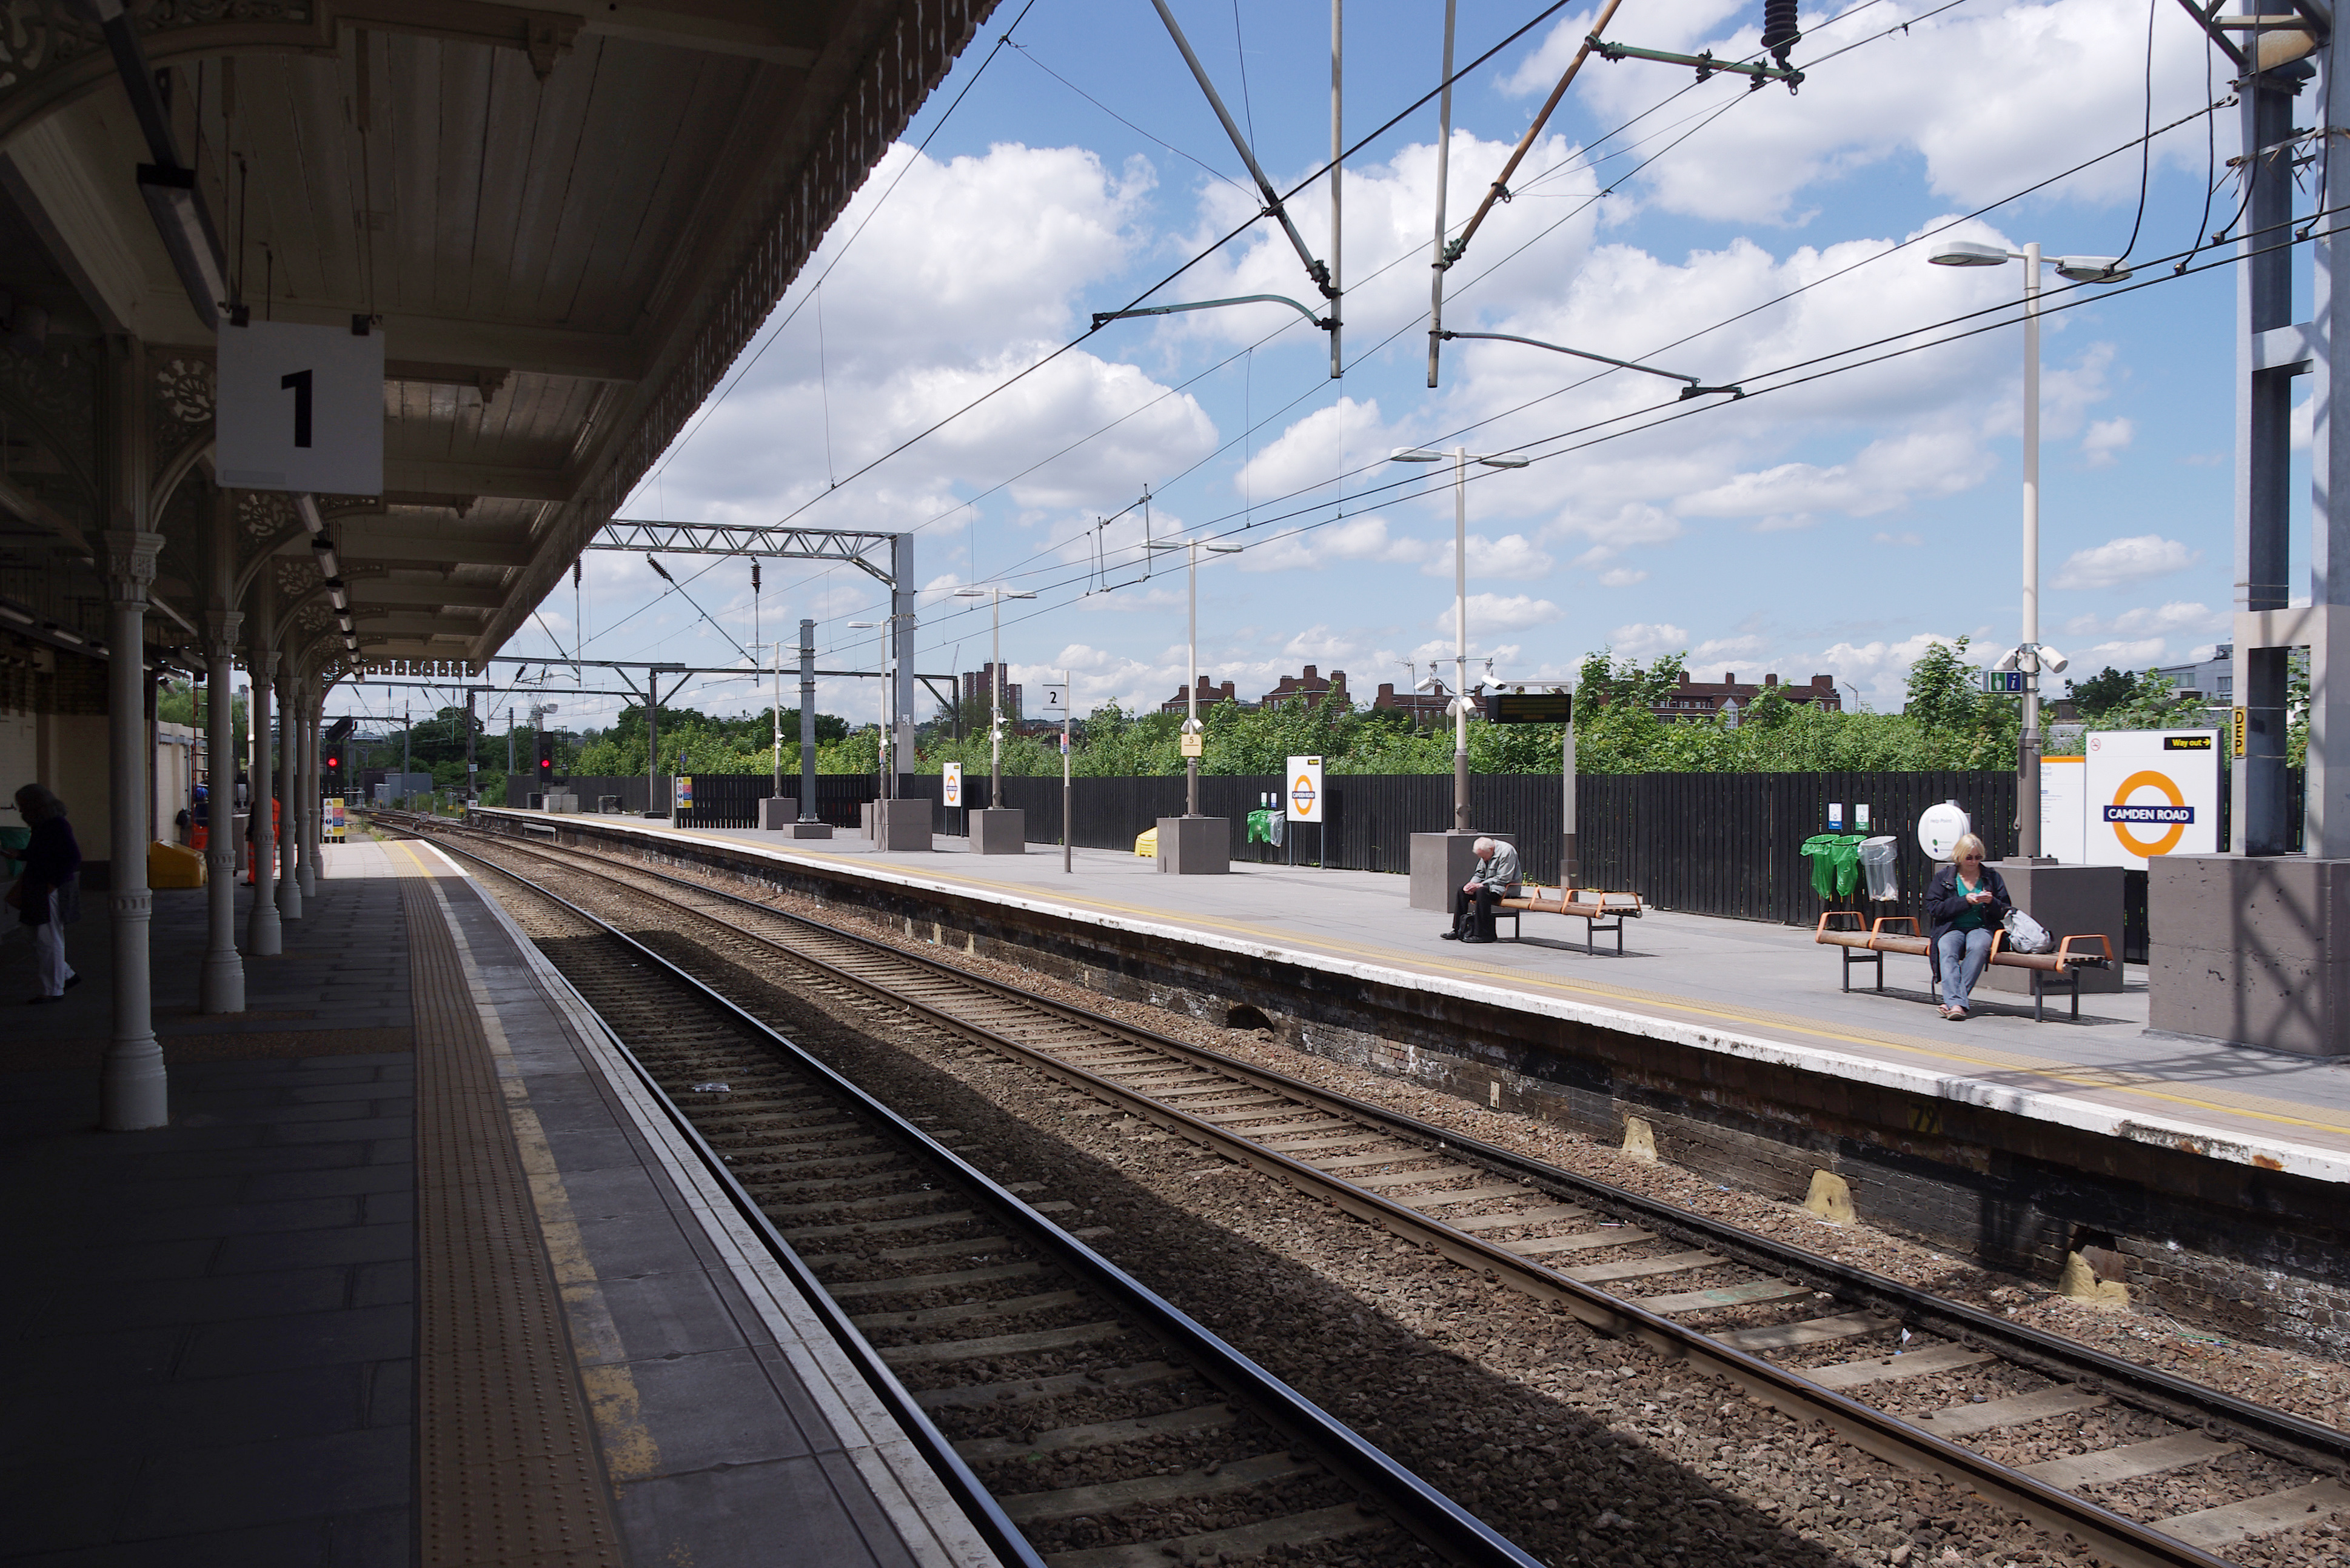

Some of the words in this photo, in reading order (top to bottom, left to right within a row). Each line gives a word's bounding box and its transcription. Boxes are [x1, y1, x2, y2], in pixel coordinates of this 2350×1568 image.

[281, 369, 313, 448] 1
[1049, 691, 1057, 704] 2
[2235, 711, 2244, 752] DEP
[2172, 739, 2188, 748] Way
[2107, 808, 2155, 820] CAMDEN
[2157, 809, 2189, 821] ROAD
